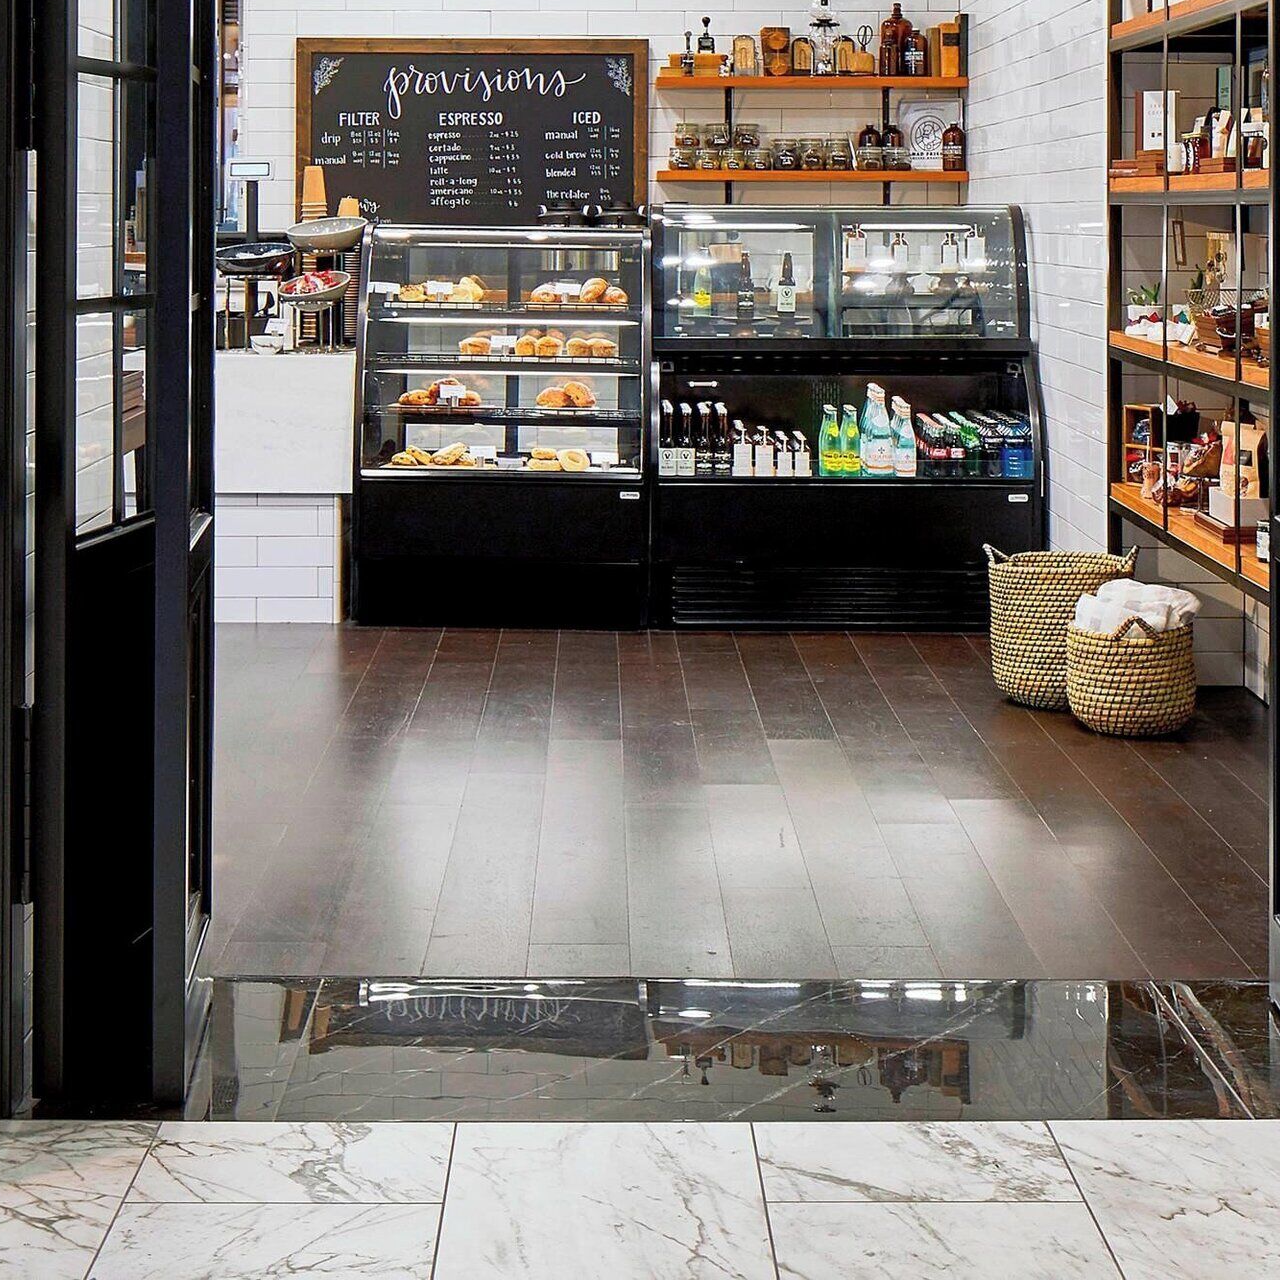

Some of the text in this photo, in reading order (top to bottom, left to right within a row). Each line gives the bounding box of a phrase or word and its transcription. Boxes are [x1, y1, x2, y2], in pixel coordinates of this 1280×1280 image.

[383, 64, 586, 120] provisions
[339, 112, 380, 126] FILTER
[439, 112, 503, 126] ESPRESSO
[573, 111, 601, 124] ICED
[321, 132, 341, 146] drip
[428, 131, 461, 141] espresso
[545, 130, 578, 140] manual
[429, 143, 462, 153] cortado
[315, 155, 346, 165] manual
[429, 154, 472, 165] cappuccino
[545, 150, 587, 160] cold brew
[430, 167, 449, 175] latte
[545, 167, 576, 178] blended
[430, 177, 478, 187] roll-a-long
[546, 190, 559, 199] the
[430, 197, 471, 208] affogato
